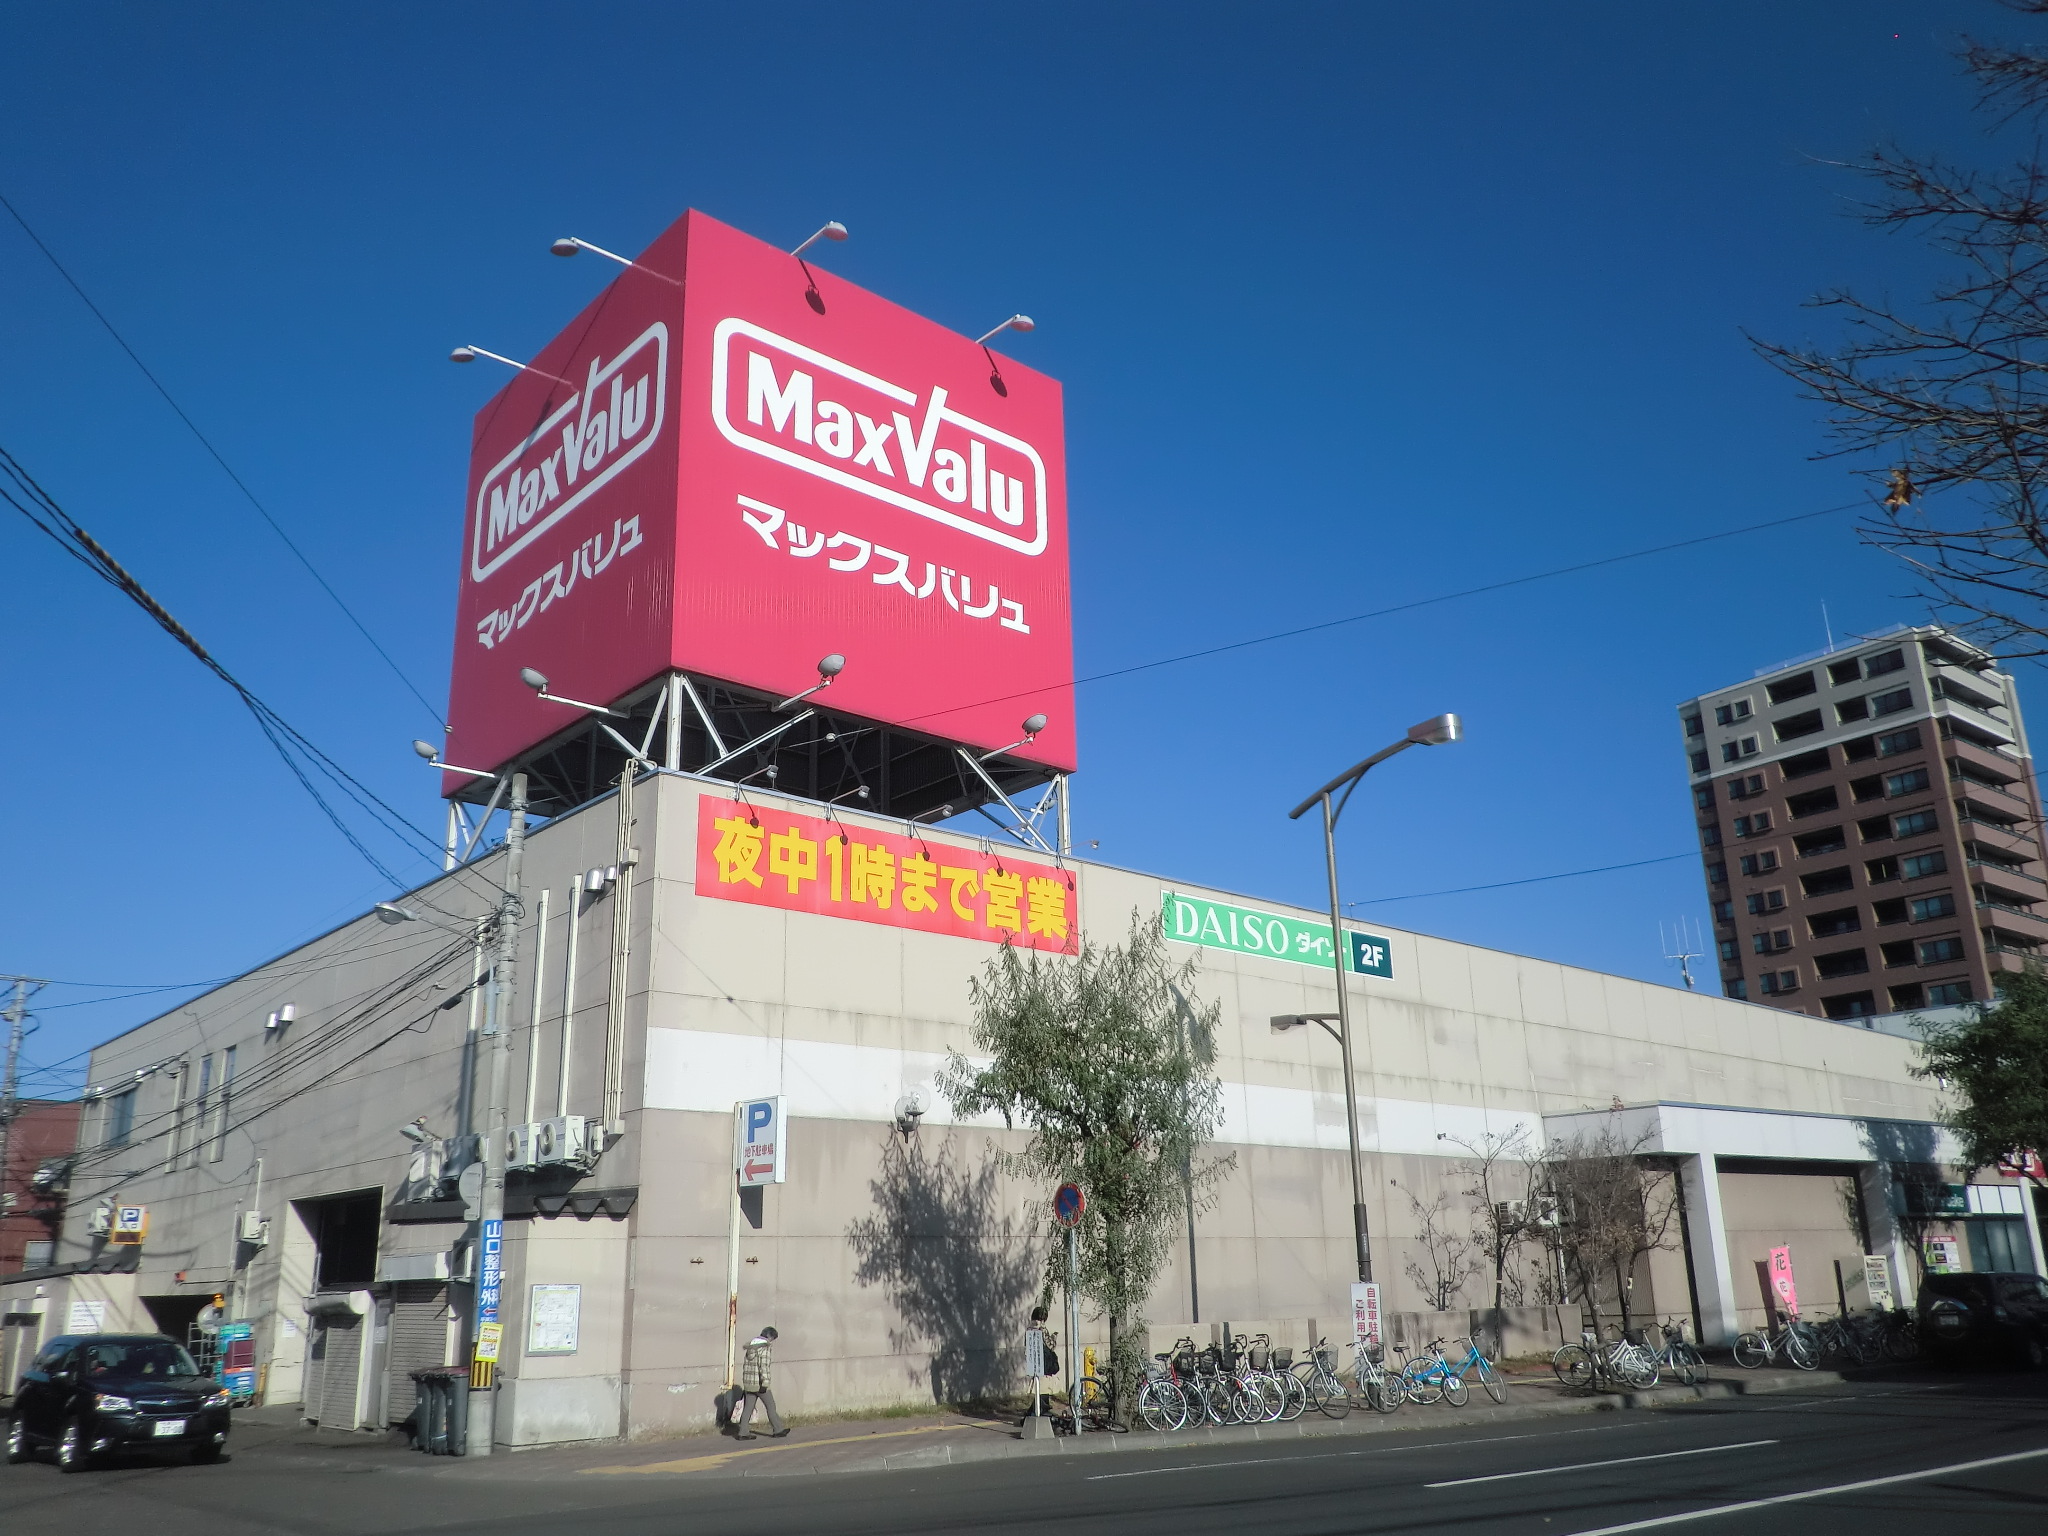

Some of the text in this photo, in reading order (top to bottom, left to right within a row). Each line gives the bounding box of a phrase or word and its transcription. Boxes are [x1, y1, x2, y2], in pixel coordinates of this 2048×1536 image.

[487, 355, 648, 552] MaxValu
[748, 350, 1024, 526] MaxValu
[477, 514, 642, 649] マックスバリュ
[737, 494, 1030, 634] マックスバリュ
[713, 816, 1067, 940] 夜中1時まで営業
[1174, 900, 1384, 968] DAISO ダイソ 2F
[744, 1143, 774, 1158] 地下駐車場
[748, 1103, 772, 1143] P
[123, 1209, 139, 1221] P
[481, 1222, 501, 1305] 山口整形外科
